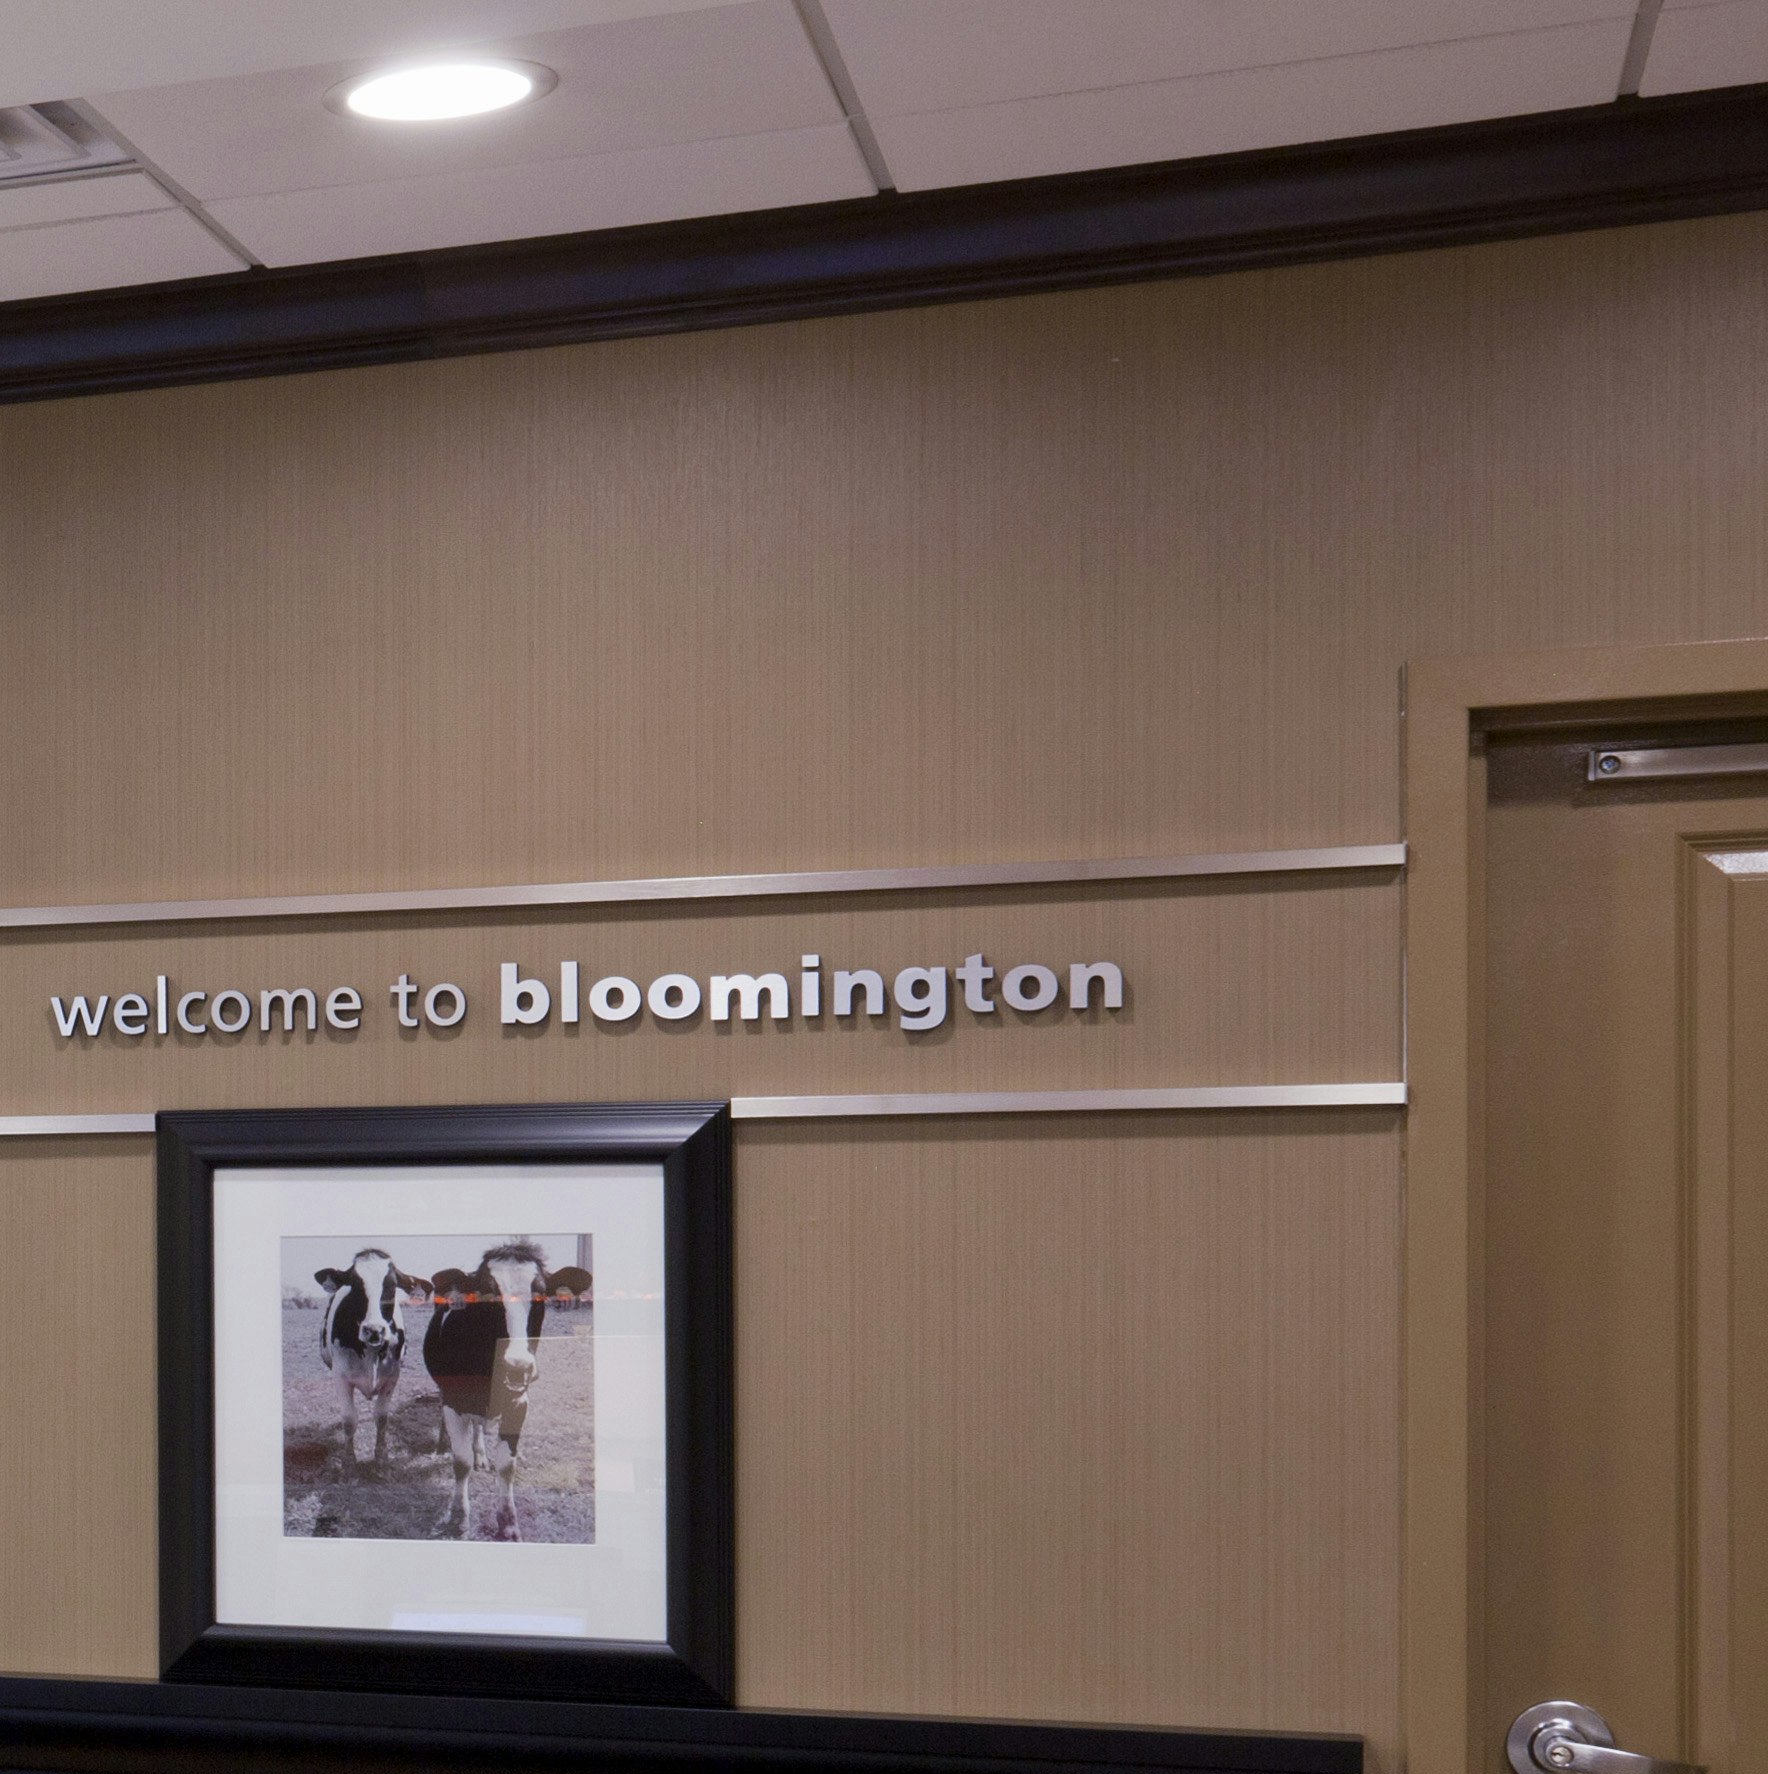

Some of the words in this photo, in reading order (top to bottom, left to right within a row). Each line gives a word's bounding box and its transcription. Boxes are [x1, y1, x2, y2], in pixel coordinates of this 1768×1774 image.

[49, 976, 362, 1038] welcome
[389, 972, 466, 1028] to
[499, 952, 1126, 1032] bloomington
